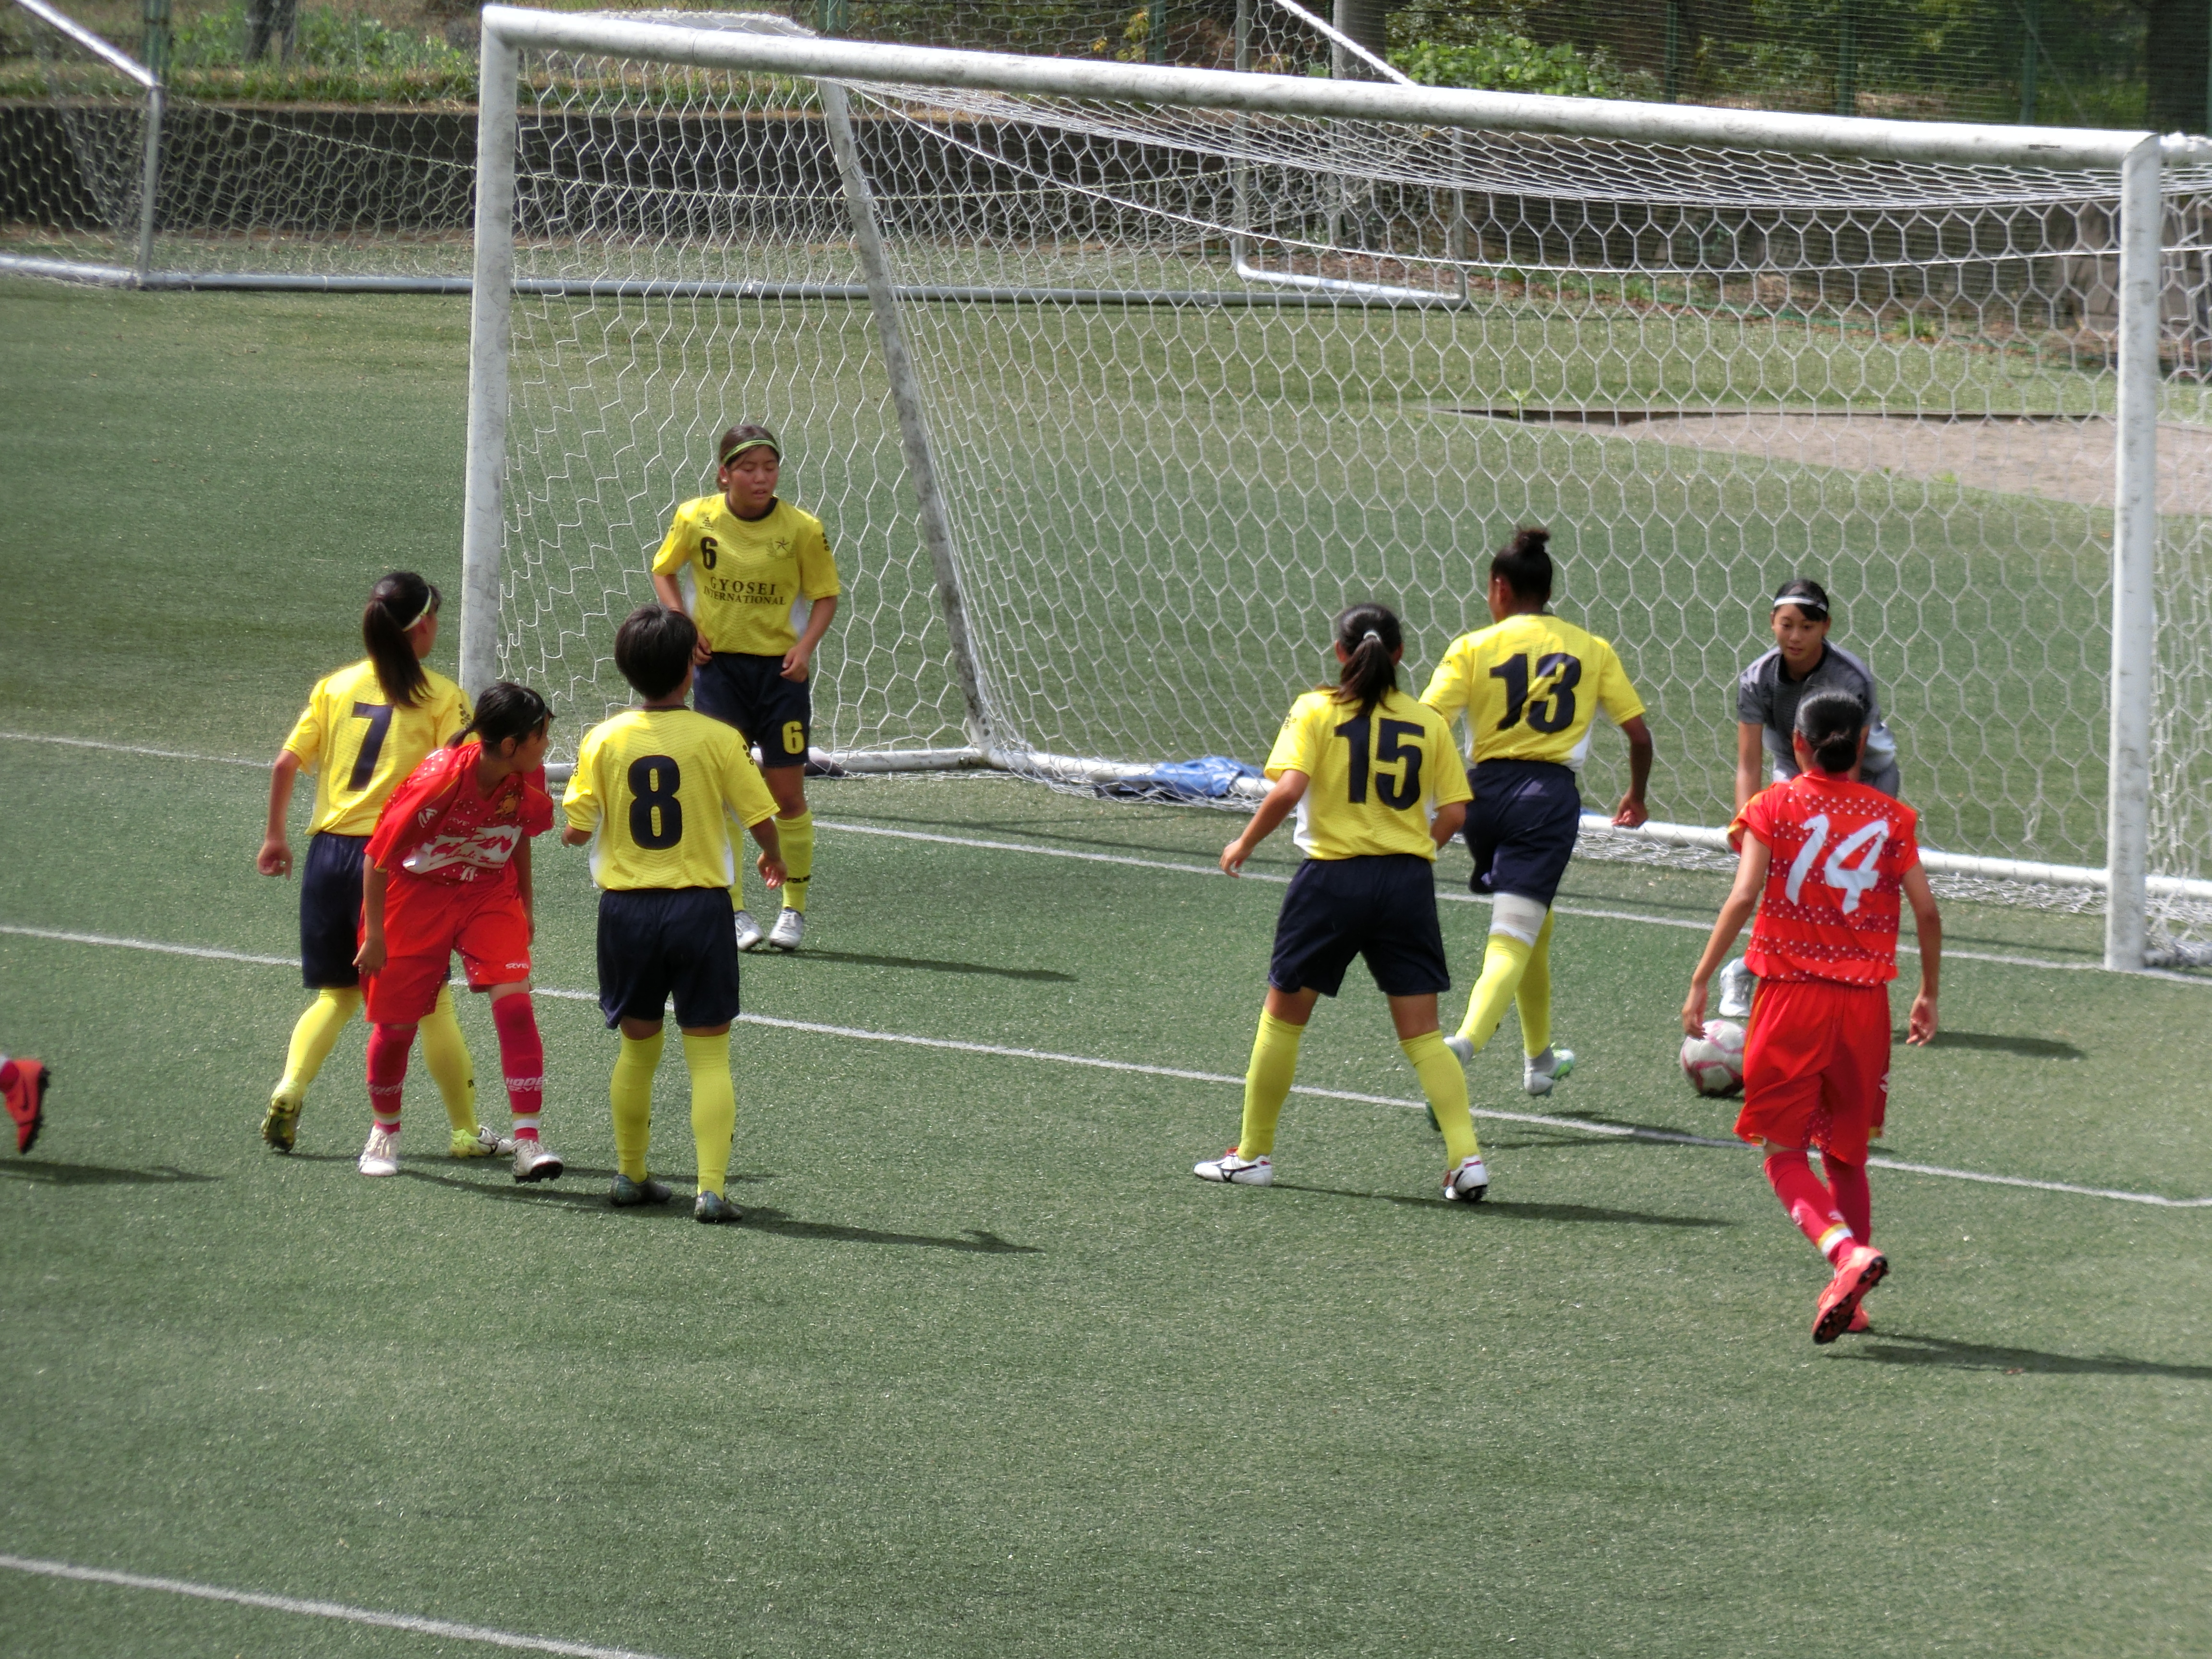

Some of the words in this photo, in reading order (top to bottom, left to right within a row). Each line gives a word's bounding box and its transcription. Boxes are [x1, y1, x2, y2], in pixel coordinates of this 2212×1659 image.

[700, 536, 718, 570] 6
[710, 577, 776, 596] GYOSEI
[704, 585, 786, 605] INTERNATIONAL
[1490, 652, 1582, 735] 13
[347, 701, 394, 792] 7
[782, 721, 805, 754] 6
[1334, 714, 1425, 811] 15
[627, 755, 683, 851] 8
[1785, 813, 1890, 915] 14
